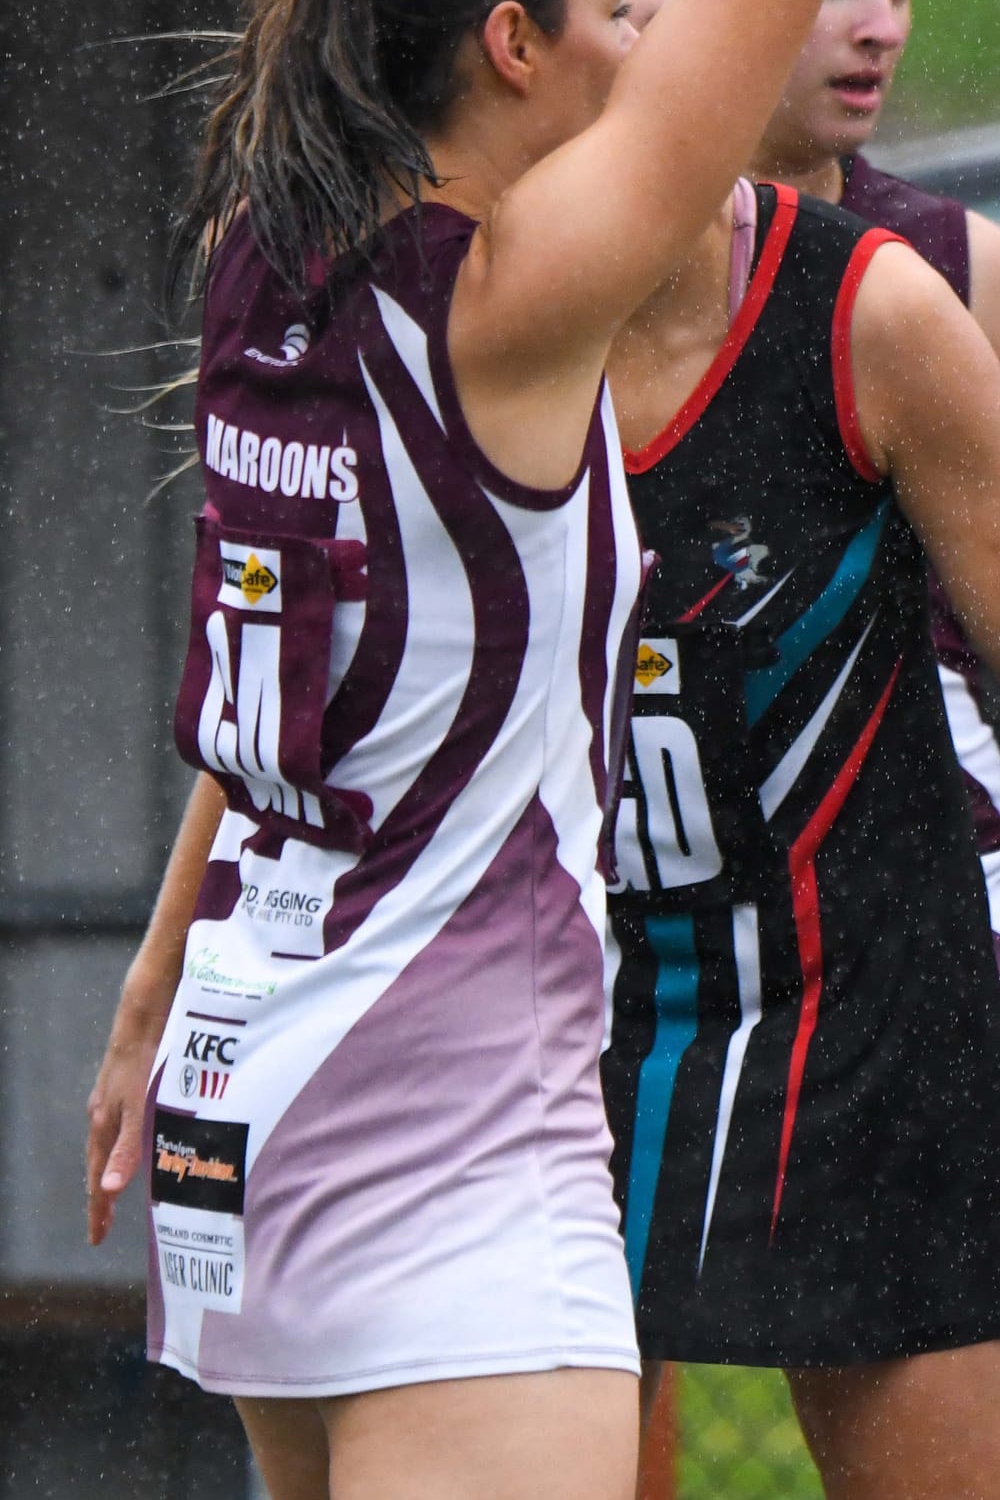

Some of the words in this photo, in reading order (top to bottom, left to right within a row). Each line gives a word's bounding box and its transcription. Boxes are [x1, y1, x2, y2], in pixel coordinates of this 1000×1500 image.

[205, 413, 359, 502] MAROONS
[294, 914, 313, 927] LTD
[183, 1031, 238, 1066] KFC
[190, 1256, 234, 1297] CLINIC
